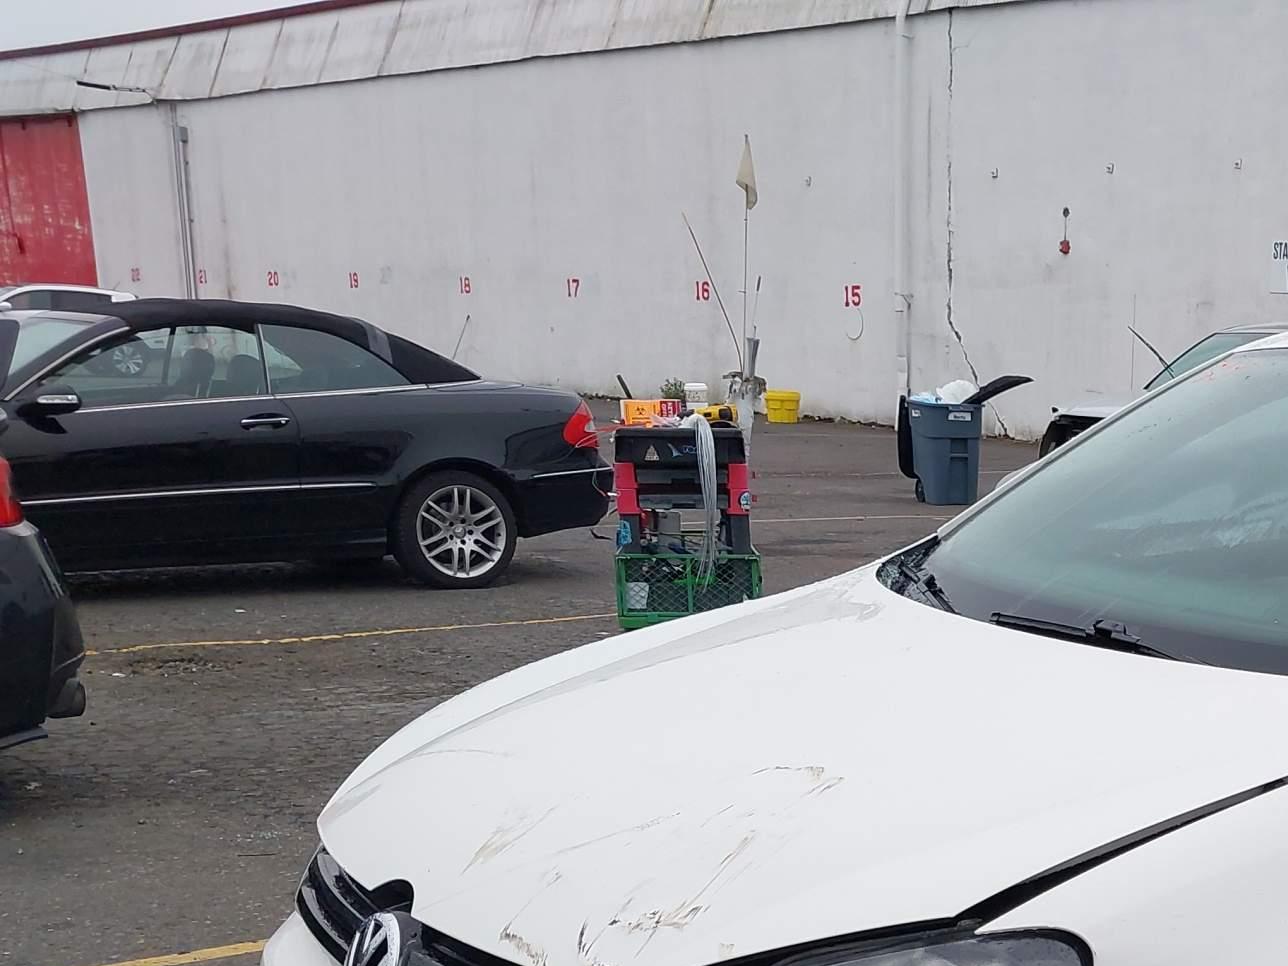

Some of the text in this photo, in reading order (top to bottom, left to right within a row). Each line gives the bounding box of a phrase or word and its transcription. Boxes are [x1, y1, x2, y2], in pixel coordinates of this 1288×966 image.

[267, 271, 279, 286] 20
[460, 276, 471, 294] 18
[567, 278, 580, 297] 17
[696, 280, 710, 301] 16
[844, 285, 861, 307] 15
